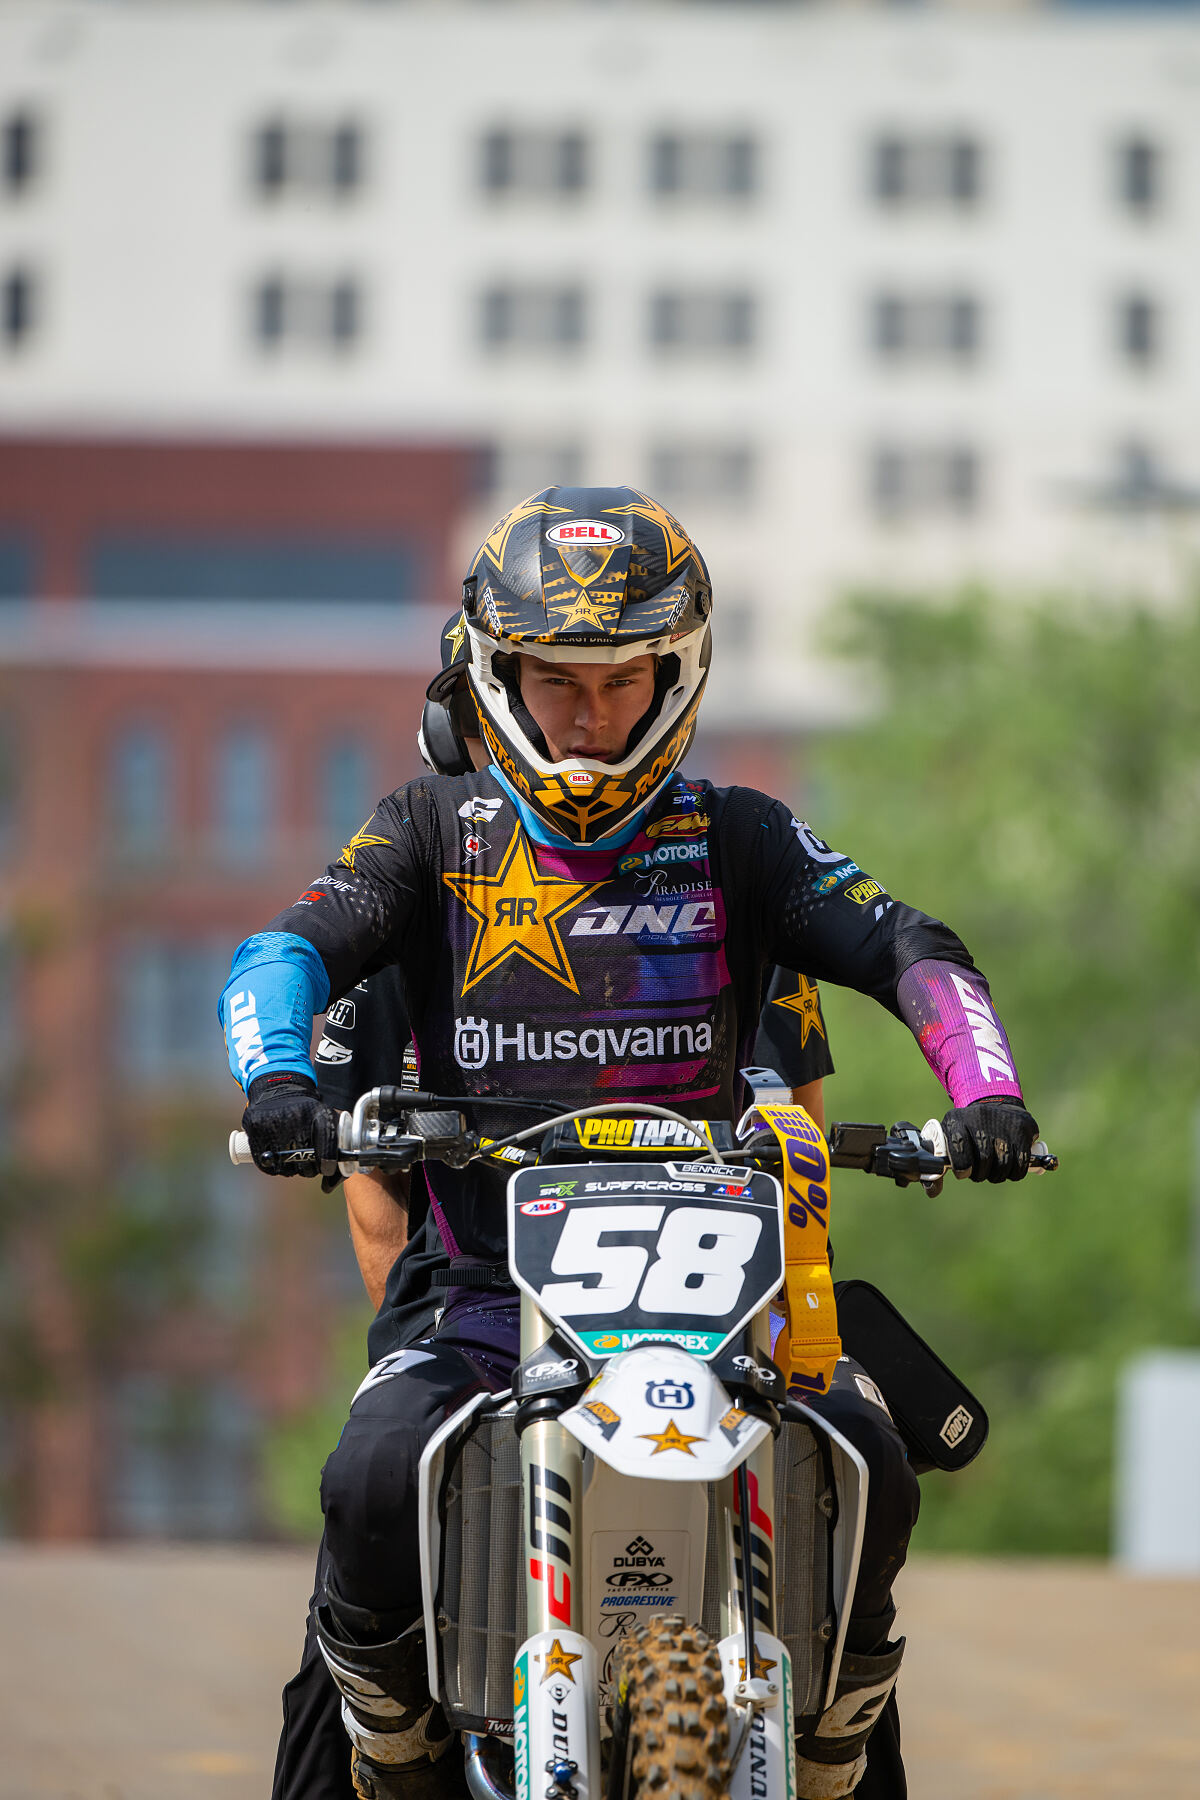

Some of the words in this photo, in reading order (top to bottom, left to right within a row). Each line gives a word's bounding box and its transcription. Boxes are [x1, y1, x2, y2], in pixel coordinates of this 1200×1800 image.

[559, 526, 614, 540] BELL
[644, 842, 709, 867] MOTORE
[634, 869, 713, 897] PARADISE
[495, 1021, 712, 1065] Husqvarna
[681, 1164, 737, 1176] BENNICK
[539, 1181, 579, 1197] SMX
[584, 1180, 707, 1193] SUPERCROSS
[712, 1184, 754, 1200] AMA
[529, 1203, 558, 1212] AMA
[540, 1205, 763, 1317] 58
[947, 1411, 969, 1442] 100%
[613, 1557, 666, 1567] DUBYA
[600, 1595, 680, 1607] PROGRESSIVE
[514, 1705, 529, 1800] MOTOR
[750, 1702, 768, 1800] UNLO
